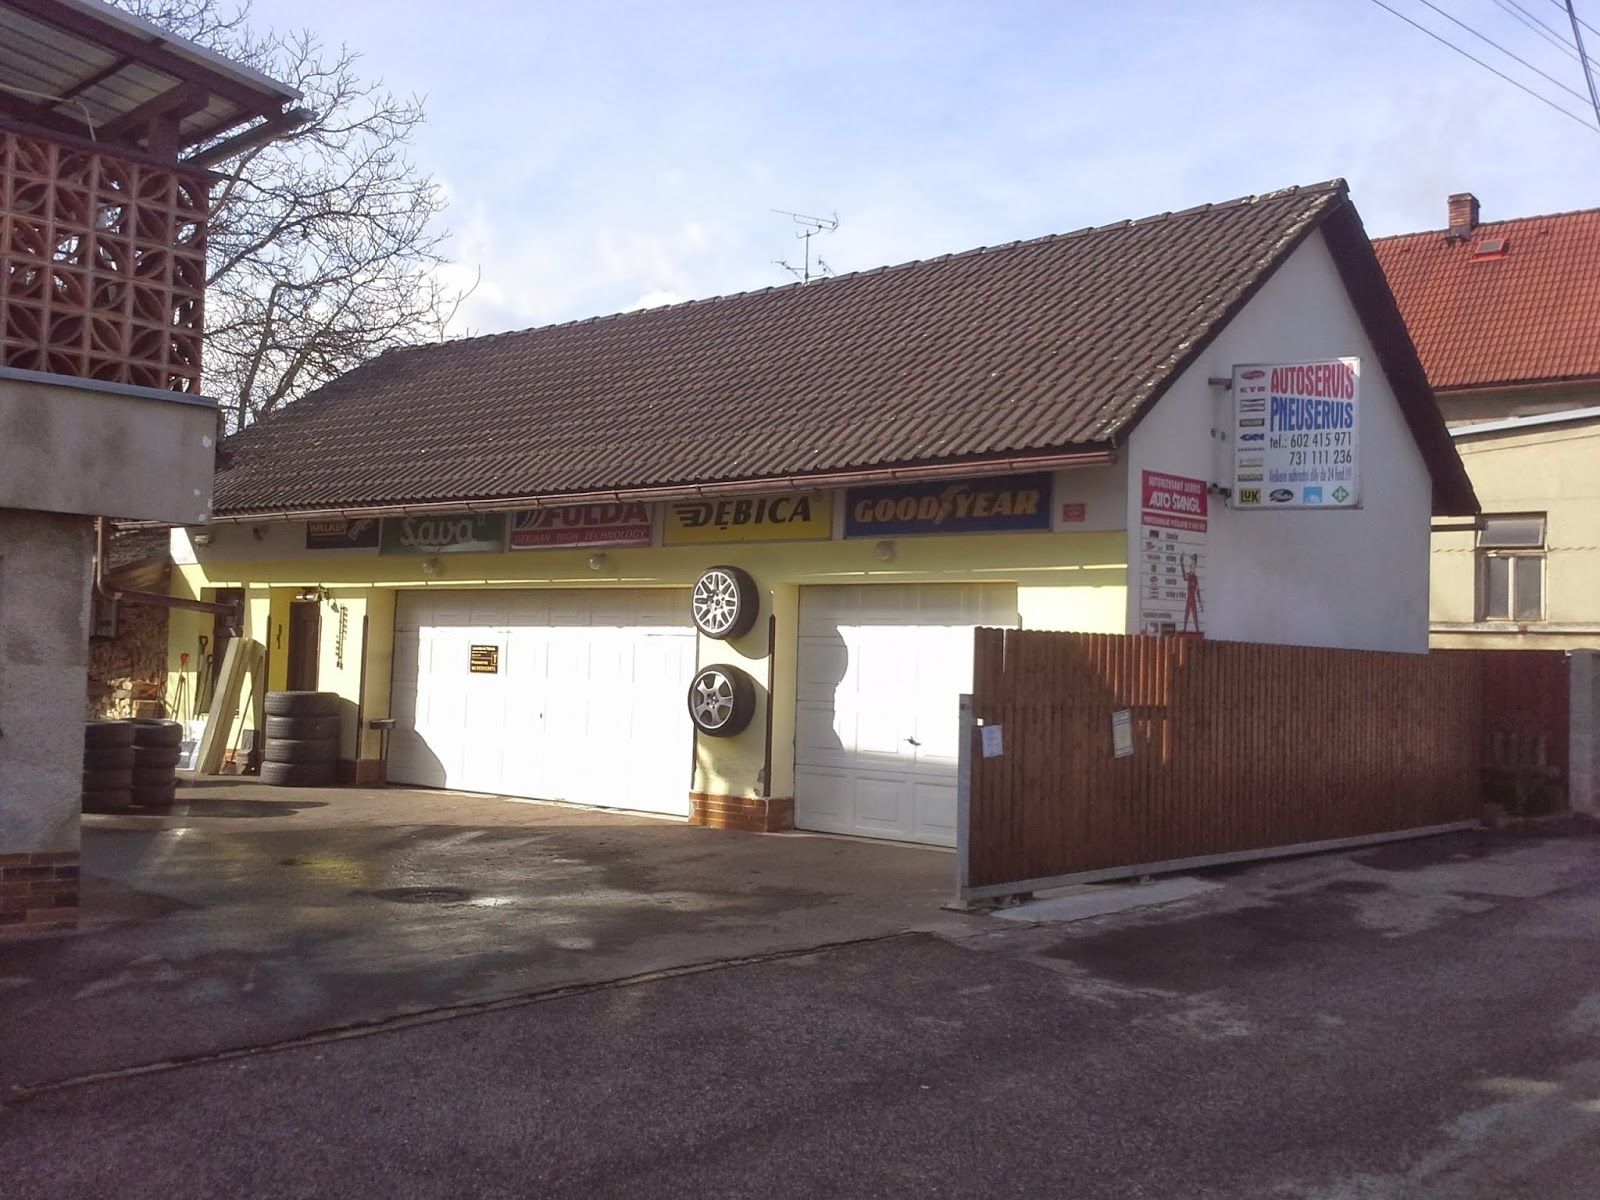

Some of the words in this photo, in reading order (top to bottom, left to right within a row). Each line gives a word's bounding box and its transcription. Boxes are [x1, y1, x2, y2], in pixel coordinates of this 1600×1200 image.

[1271, 363, 1355, 399] AUTOSERVIS
[1269, 396, 1353, 432] PNEUSERVIS
[1269, 434, 1288, 449] tel.:
[1290, 433, 1310, 449] 602
[1312, 432, 1331, 448] 415
[1334, 432, 1352, 447] 971
[1289, 451, 1307, 466] 731
[1311, 451, 1329, 465] 111
[1333, 450, 1352, 465] 236
[540, 502, 650, 528] FULDA
[854, 488, 1039, 523] GOODYEAR
[400, 516, 477, 546] Sava
